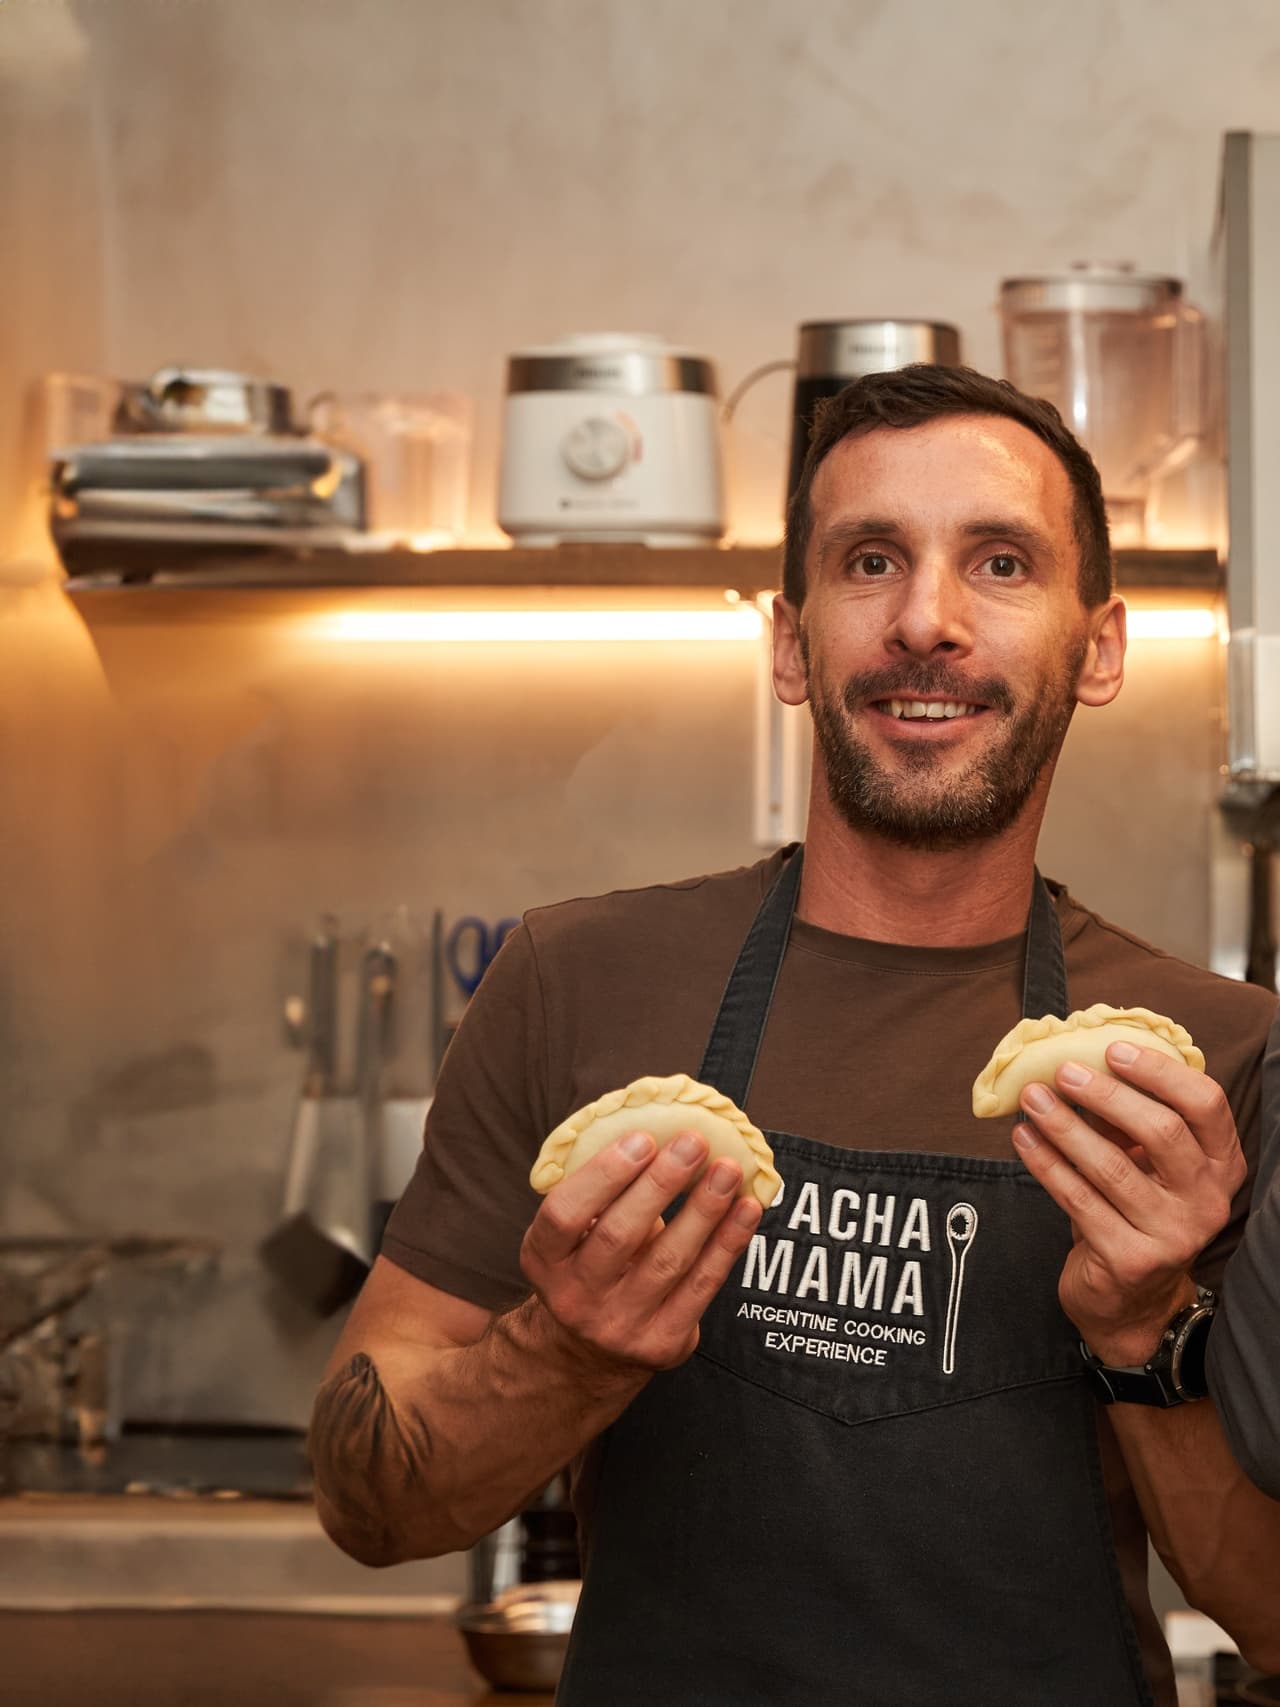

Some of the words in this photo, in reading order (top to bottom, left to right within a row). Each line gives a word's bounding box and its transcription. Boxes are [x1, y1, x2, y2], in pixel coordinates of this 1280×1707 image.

[770, 1182, 931, 1252] ACHA
[741, 1234, 925, 1316] MAMA
[736, 1302, 839, 1333] ARGENTINE
[843, 1320, 927, 1346] COOKING
[764, 1332, 888, 1366] EXPERIENCE
